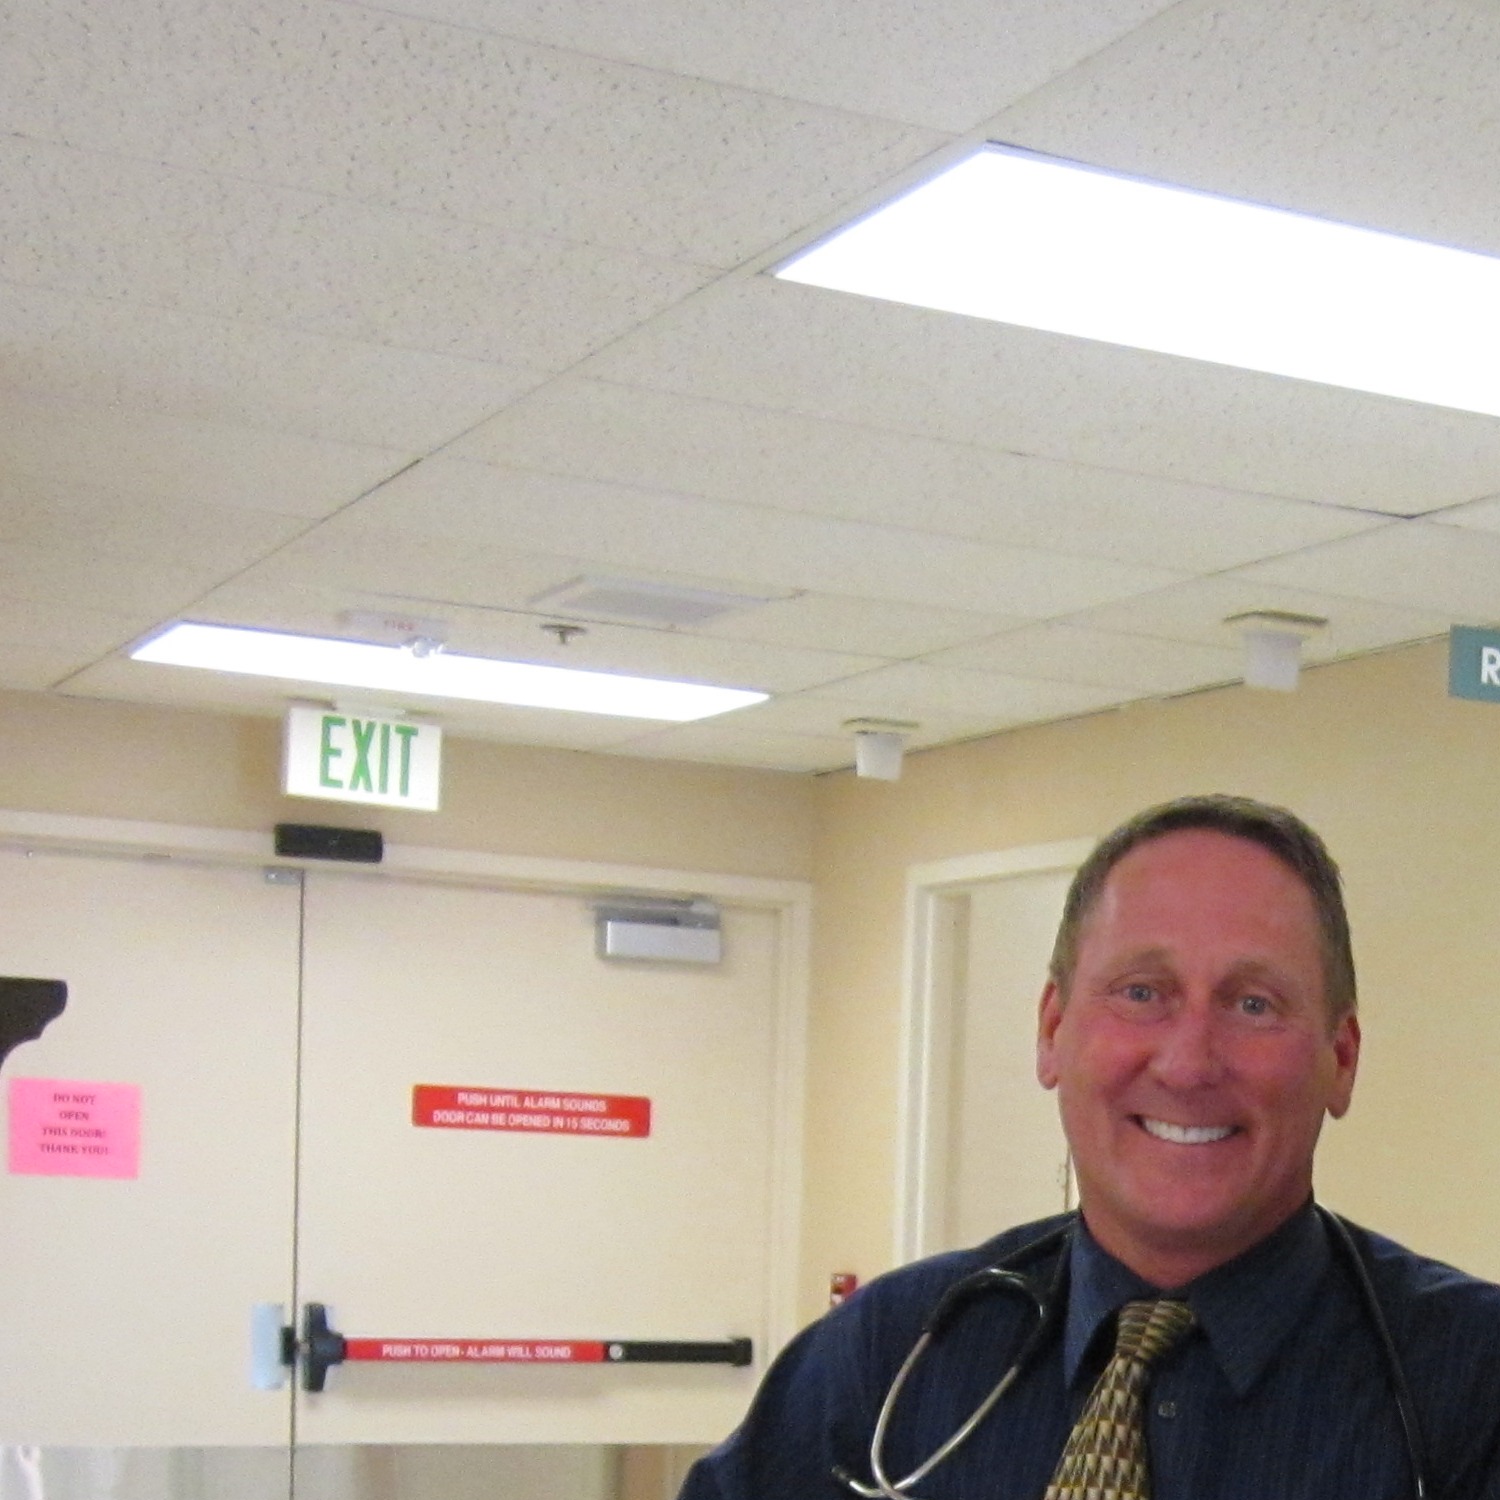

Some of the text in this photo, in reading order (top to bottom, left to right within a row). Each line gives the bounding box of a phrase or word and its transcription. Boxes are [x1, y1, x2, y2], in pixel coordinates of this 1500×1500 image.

[319, 715, 419, 797] EXIT
[53, 1093, 96, 1105] DO NOT
[457, 1092, 607, 1113] PUSH UNTIL ALARM SOUNDS
[59, 1110, 89, 1121] OPEN
[432, 1110, 630, 1132] DOOR CAN BE OPENED IN 15 SECONDS
[42, 1127, 68, 1137] THIS
[40, 1143, 78, 1154] THANK
[382, 1344, 411, 1357] PUSH
[412, 1345, 429, 1357] TO
[431, 1345, 459, 1358] OPEN
[466, 1346, 505, 1358] ALARM
[507, 1346, 533, 1358] WILL
[535, 1345, 571, 1358] SOUND
